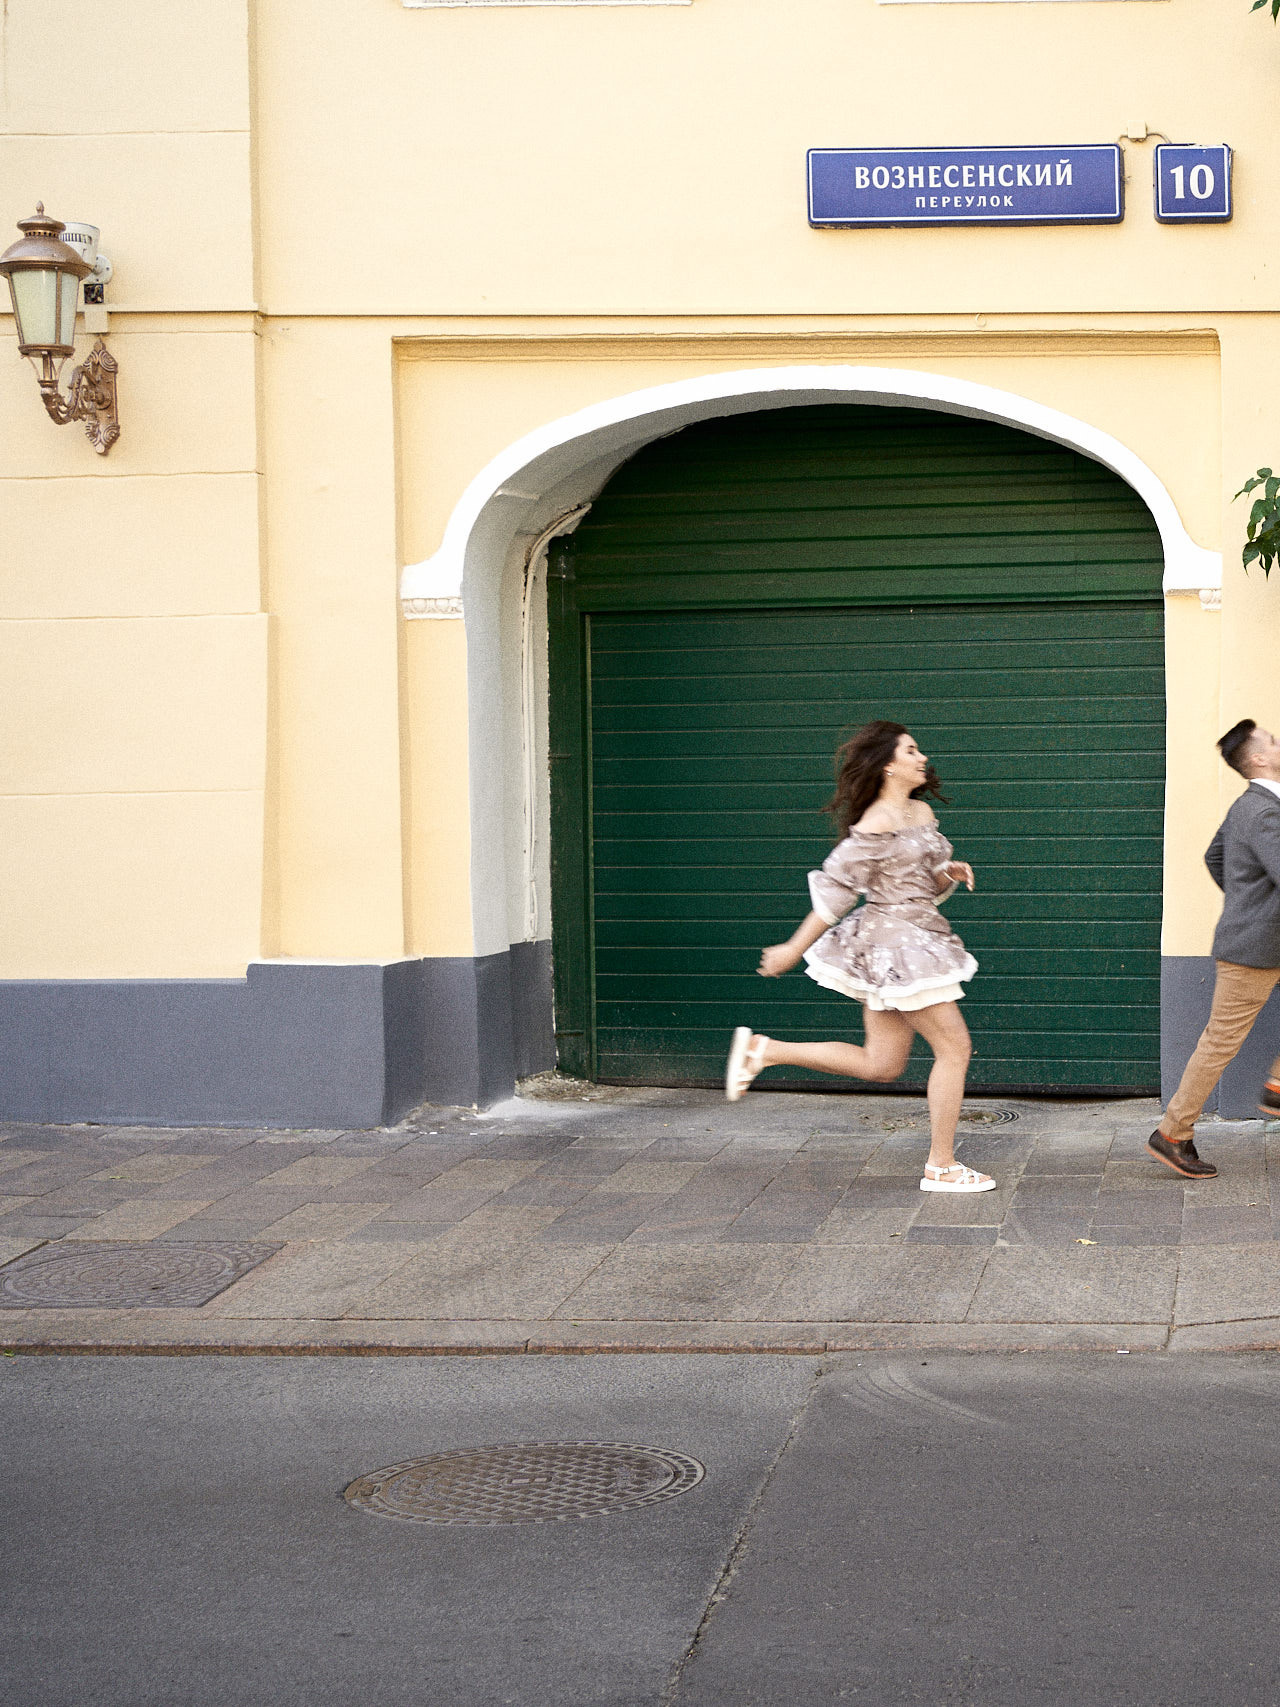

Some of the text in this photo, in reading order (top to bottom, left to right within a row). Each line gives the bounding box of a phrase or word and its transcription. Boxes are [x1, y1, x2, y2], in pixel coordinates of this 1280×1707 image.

[855, 159, 1073, 189] ВОЗНЕСЕНСКИЙ
[1170, 164, 1215, 200] 10
[915, 195, 1014, 208] ПЕРЕУЛОК
